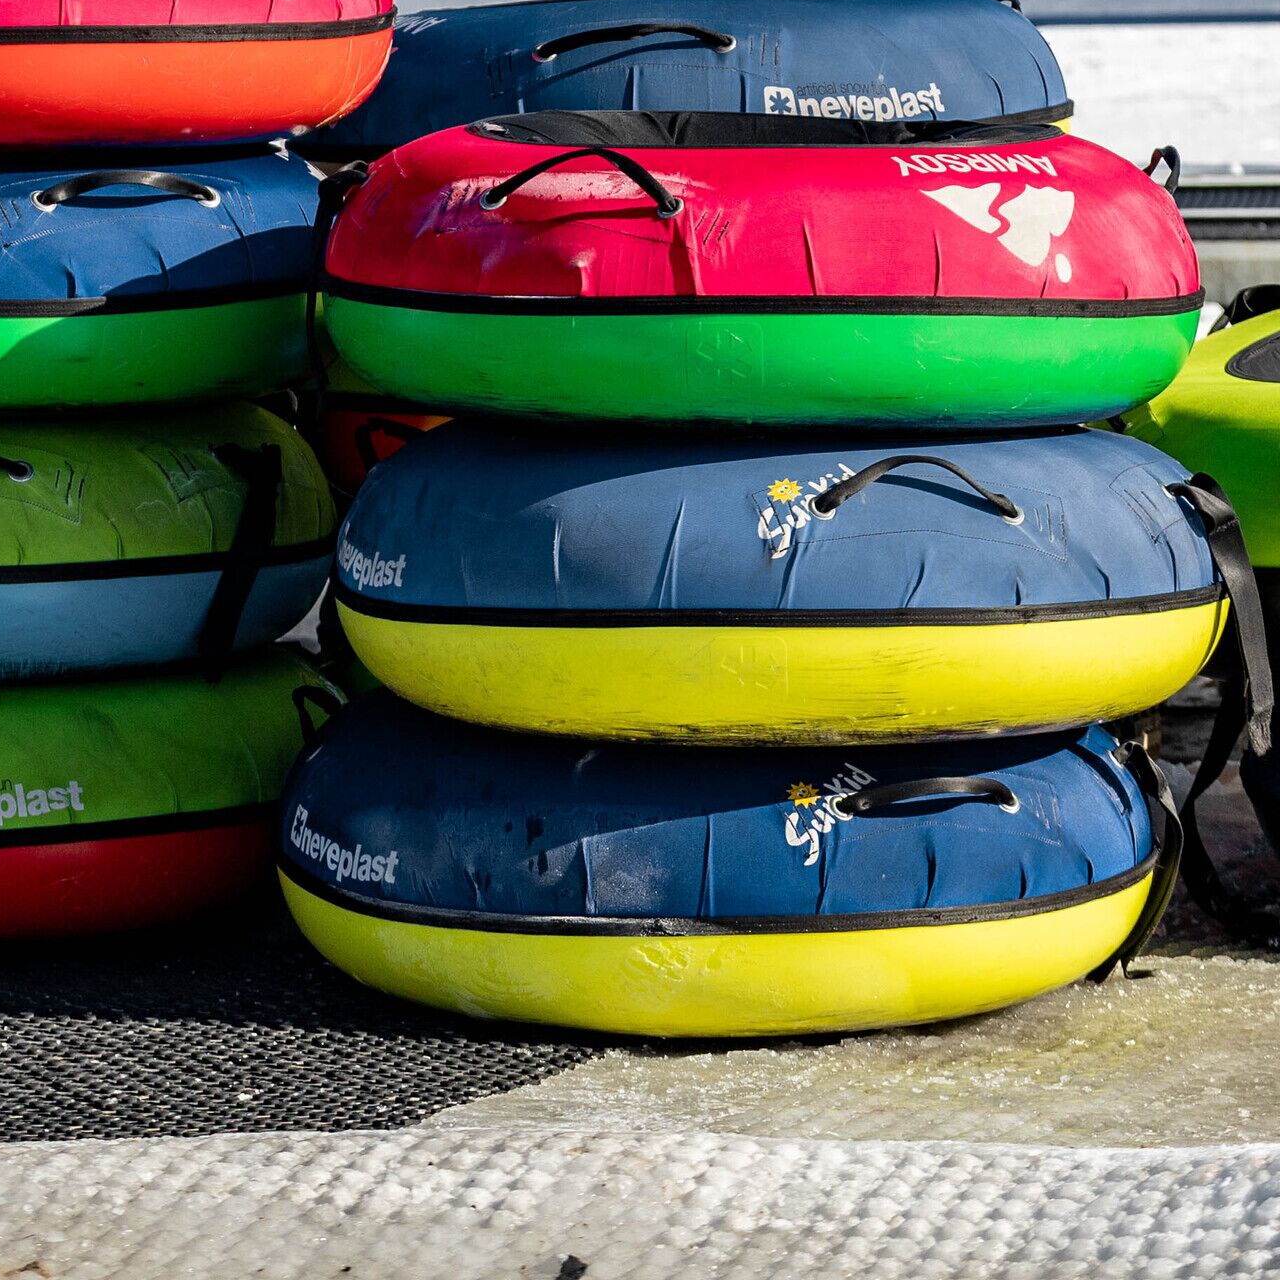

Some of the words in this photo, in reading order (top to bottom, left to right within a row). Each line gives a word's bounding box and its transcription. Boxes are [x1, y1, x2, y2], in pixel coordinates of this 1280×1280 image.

[798, 82, 946, 121] neveplast
[890, 153, 1058, 177] AMIRSOY
[301, 826, 399, 885] neveplast
